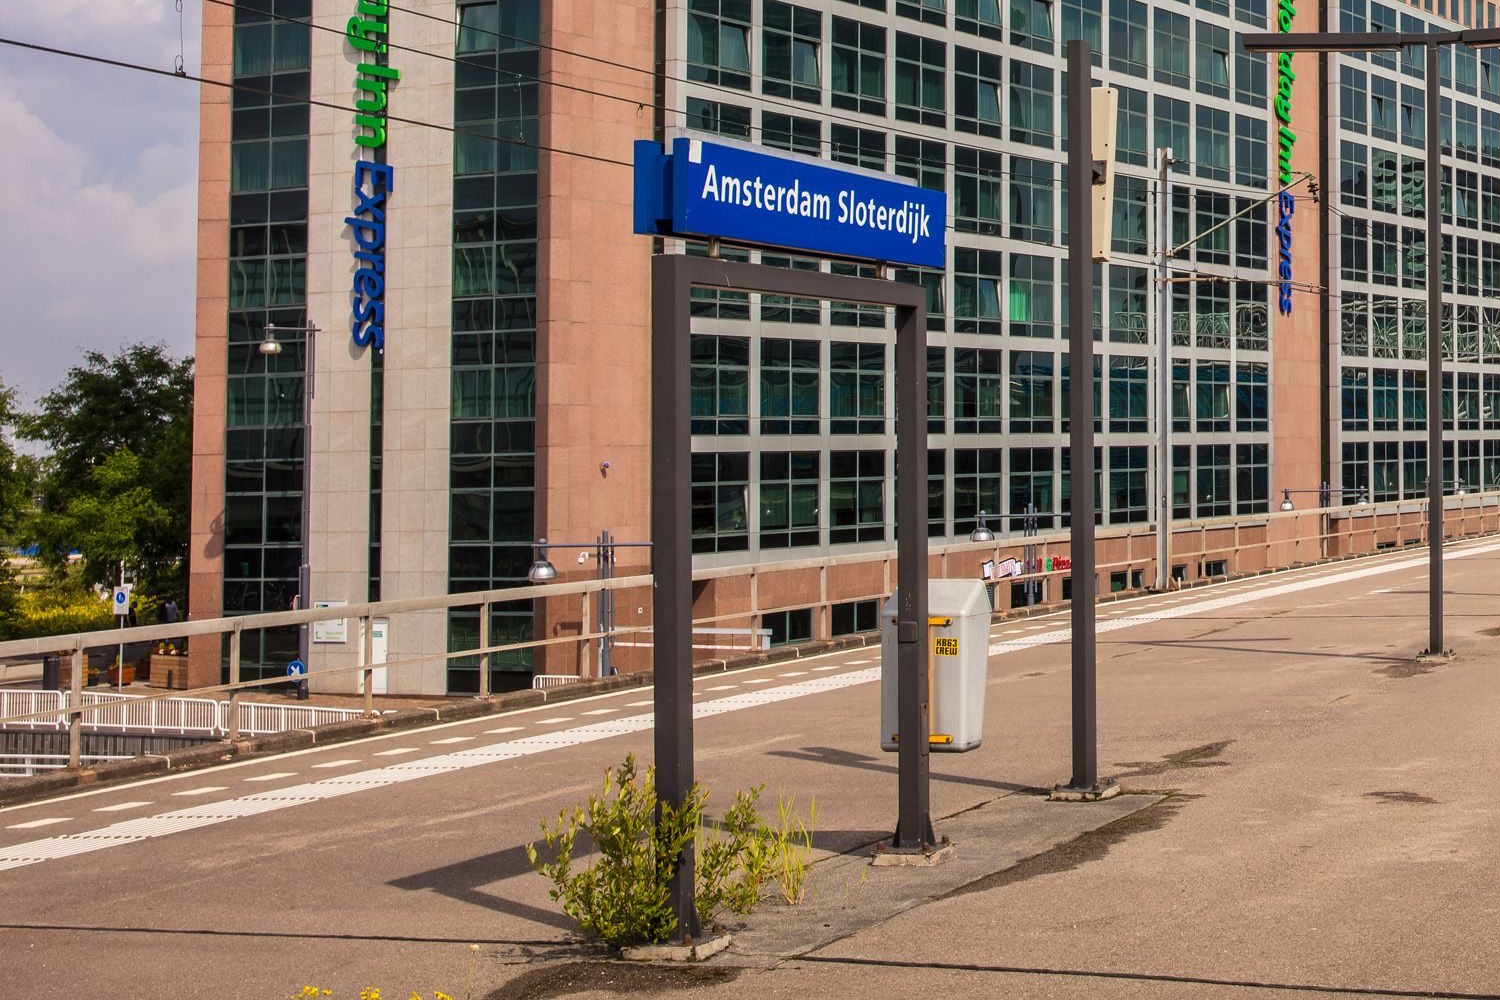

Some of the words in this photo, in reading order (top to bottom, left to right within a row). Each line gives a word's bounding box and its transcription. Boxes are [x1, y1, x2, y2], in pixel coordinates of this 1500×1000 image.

[355, 63, 401, 148] Inn
[1278, 126, 1297, 185] Inn
[701, 164, 831, 221] Amsterdam
[837, 190, 931, 245] Sloterdijk
[344, 160, 394, 348] Express
[1275, 191, 1295, 314] Express
[935, 646, 958, 656] CREW
